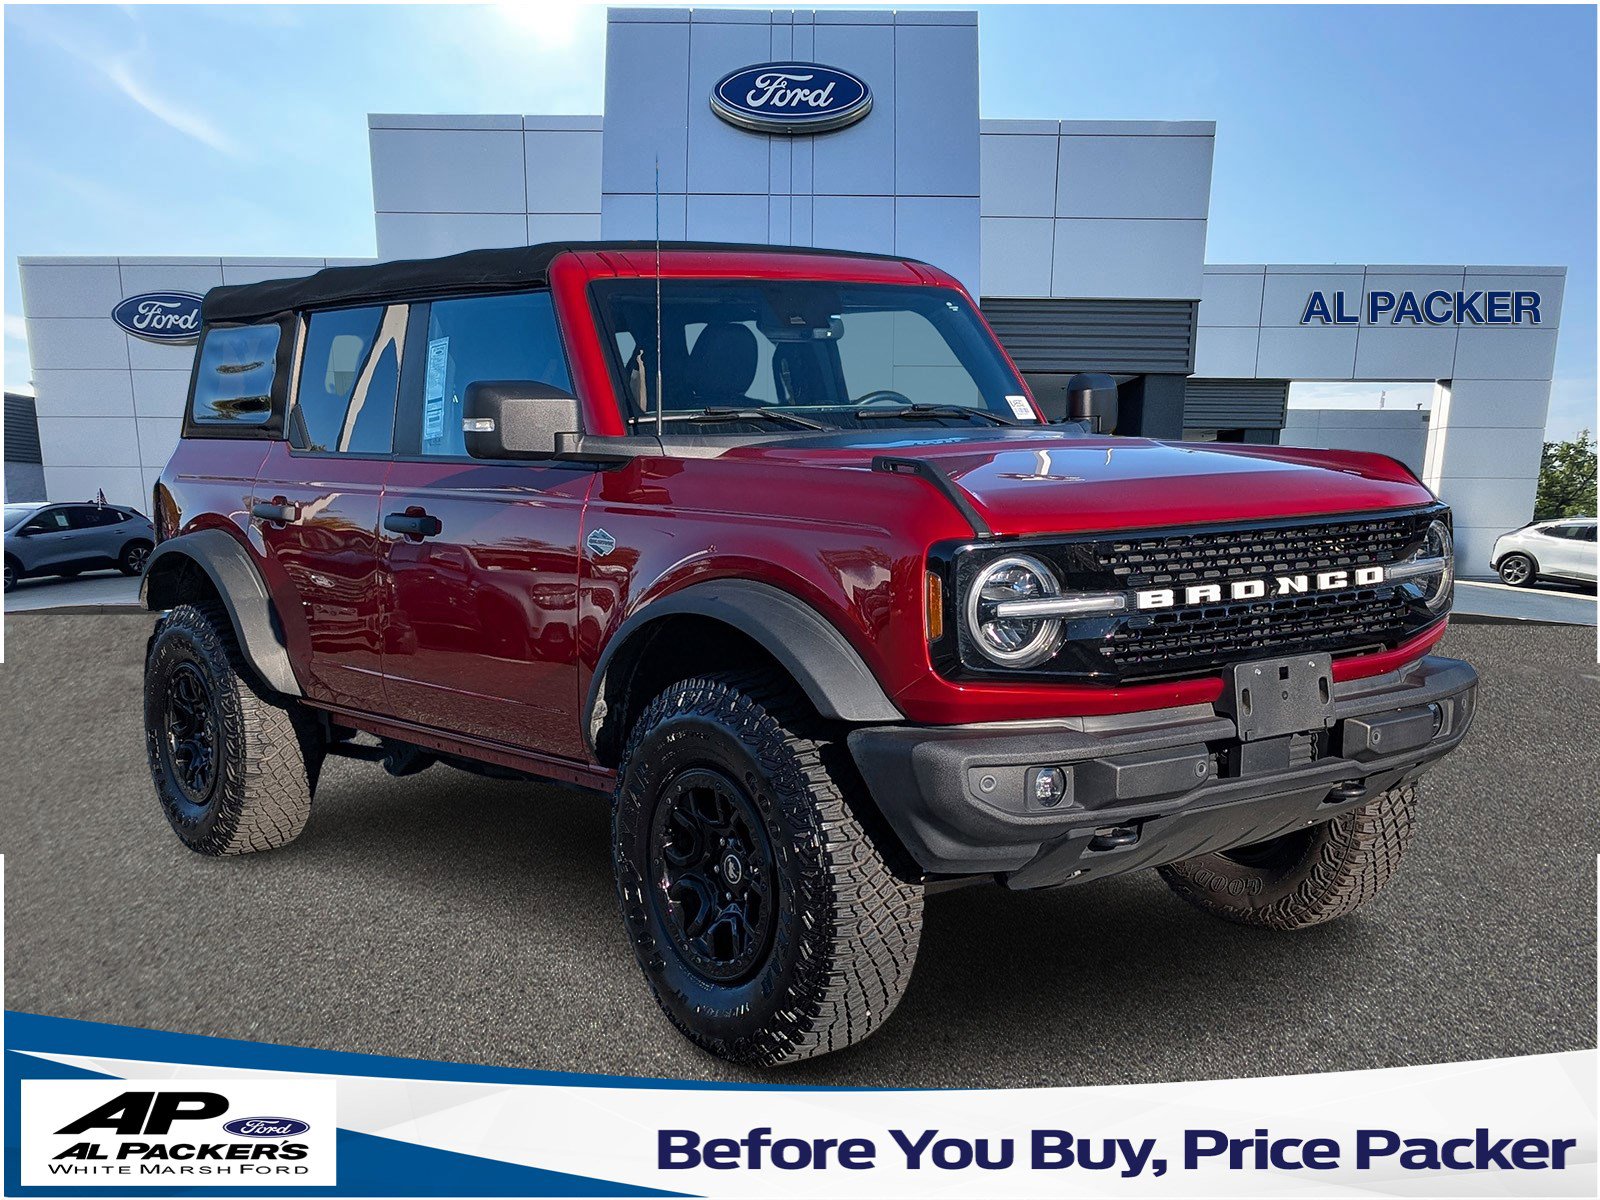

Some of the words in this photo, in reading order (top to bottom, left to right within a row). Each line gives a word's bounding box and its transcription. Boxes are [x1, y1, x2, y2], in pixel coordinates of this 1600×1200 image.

[746, 73, 836, 107] Ford
[133, 300, 199, 330] Ford
[1302, 290, 1359, 324] AL
[1370, 289, 1542, 325] PACKER
[1136, 566, 1385, 610] BRONCO
